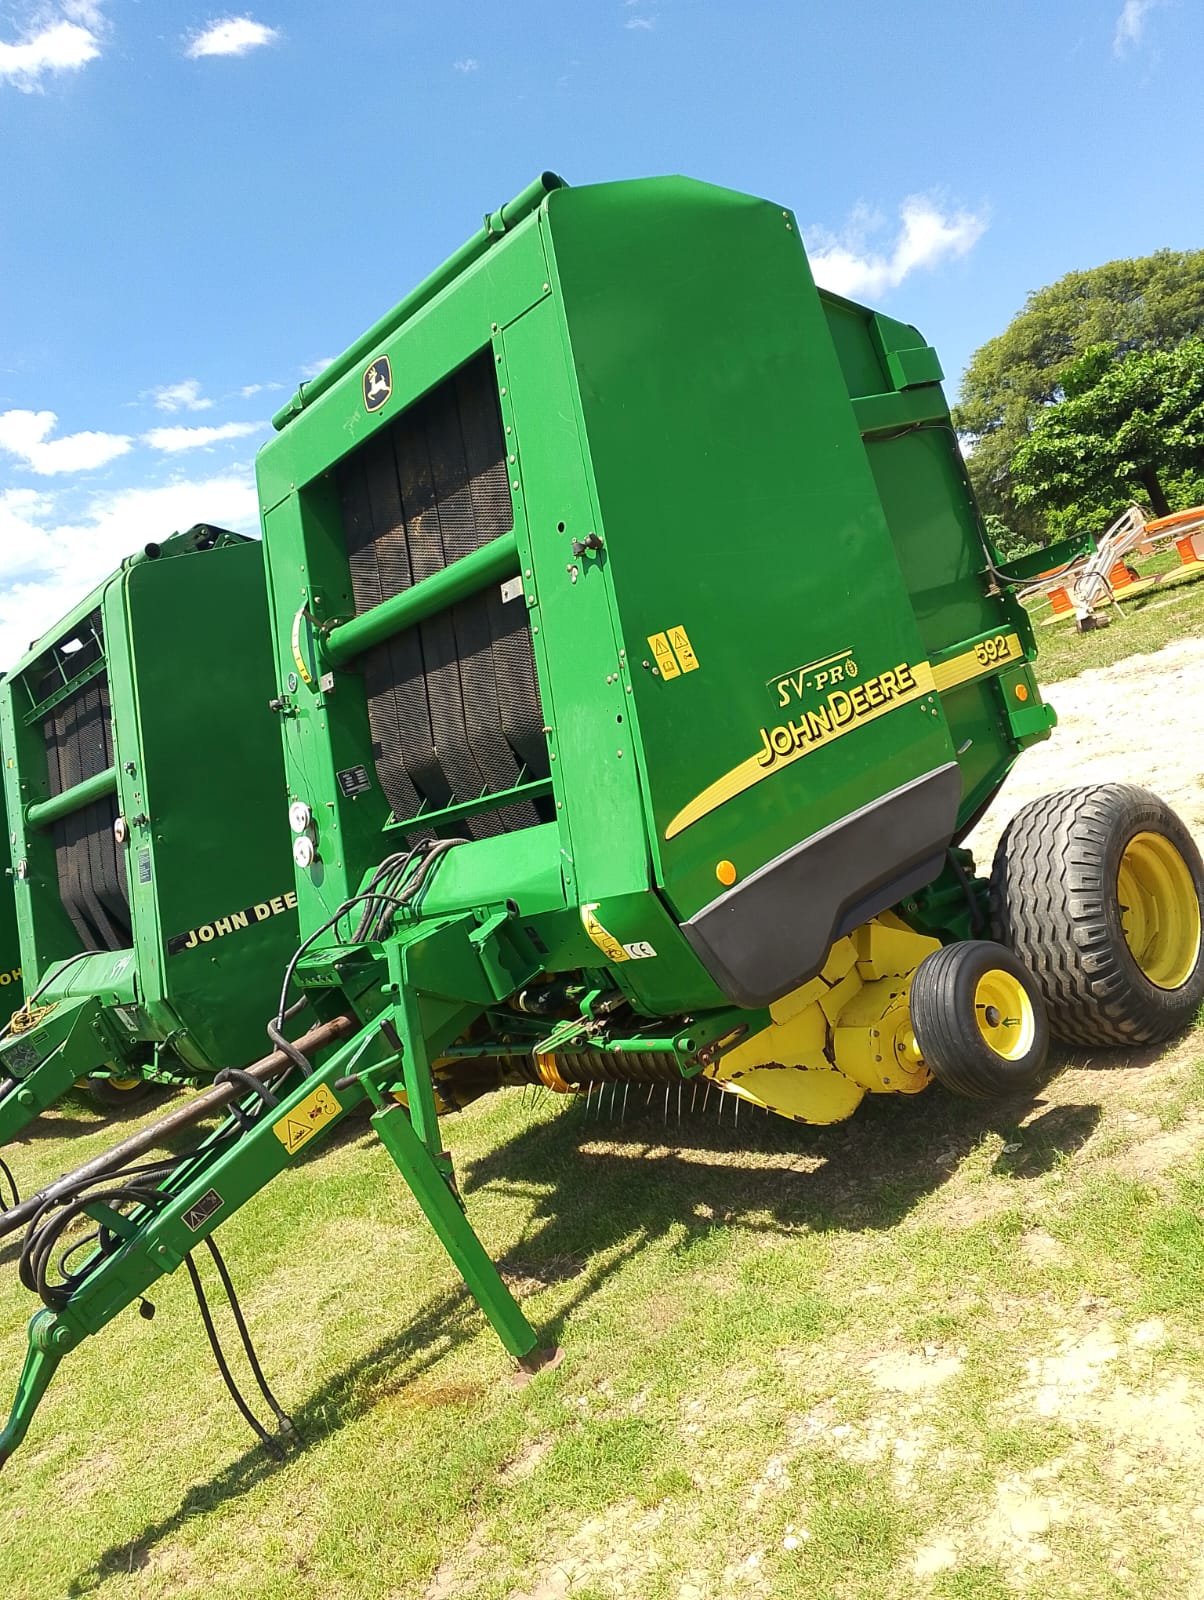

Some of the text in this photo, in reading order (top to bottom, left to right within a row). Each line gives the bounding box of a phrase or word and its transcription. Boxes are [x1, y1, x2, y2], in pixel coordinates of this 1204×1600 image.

[975, 635, 1009, 666] 592
[777, 656, 858, 708] SV-PRO
[757, 663, 916, 766] JOHN DEERE
[185, 911, 249, 948] JOHN
